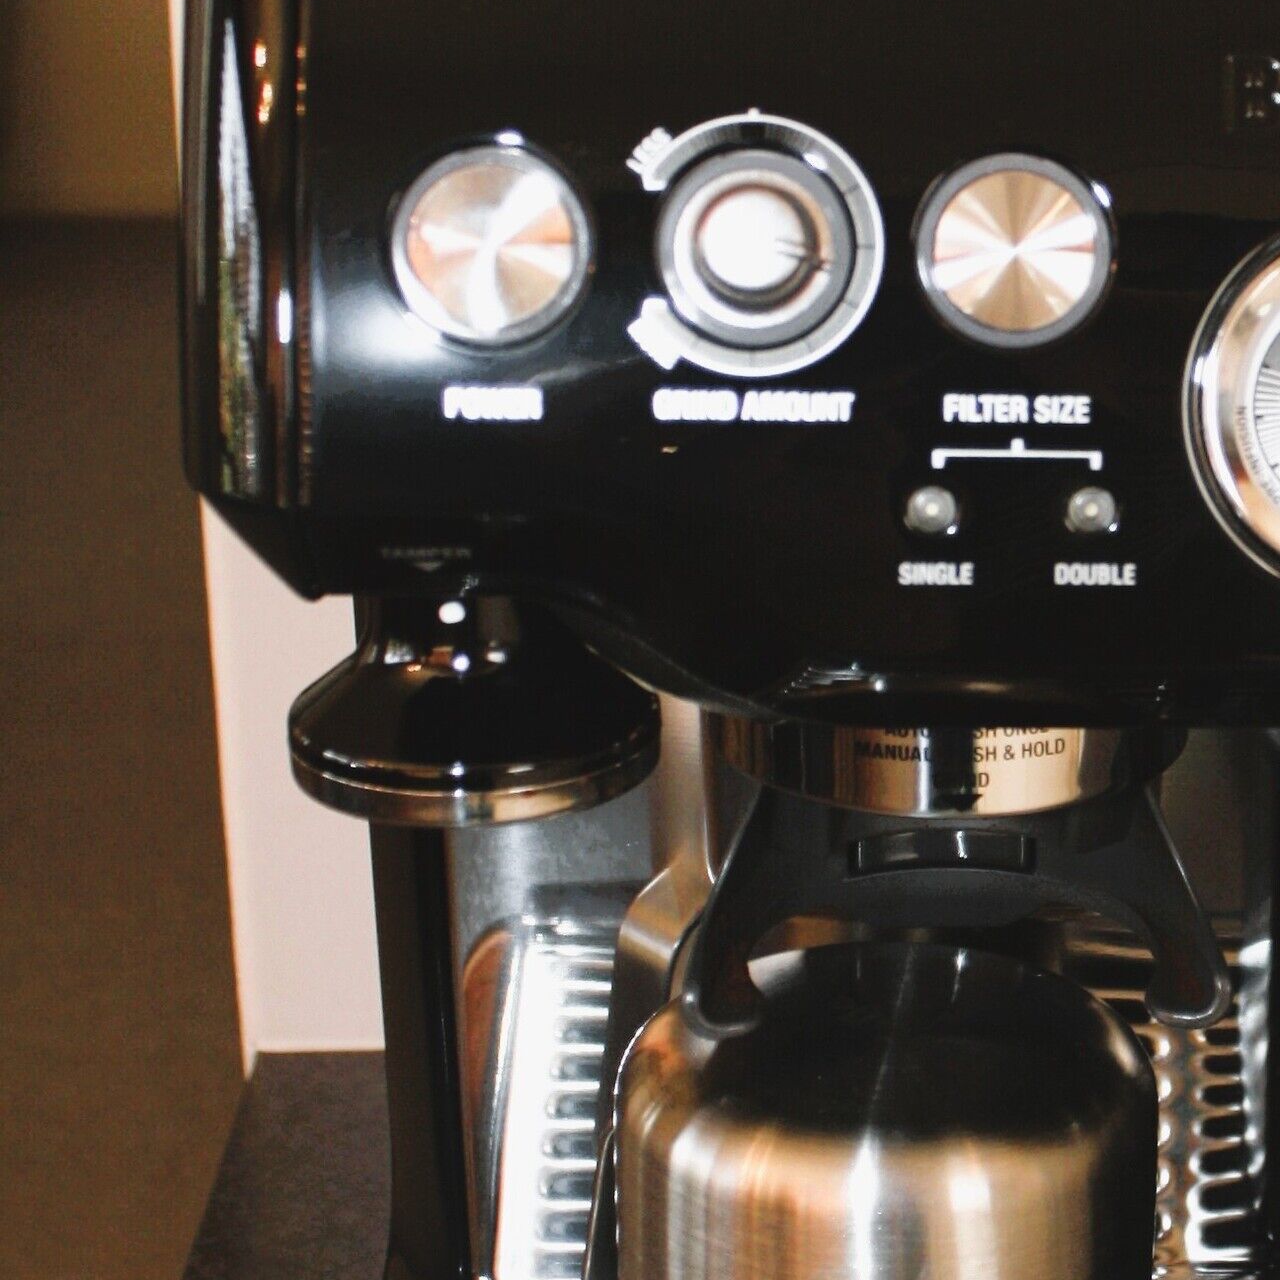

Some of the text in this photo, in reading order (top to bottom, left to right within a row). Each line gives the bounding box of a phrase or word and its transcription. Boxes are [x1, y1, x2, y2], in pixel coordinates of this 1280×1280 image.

[652, 388, 856, 423] GRIND AMOUNT
[943, 392, 1091, 425] FILTER SIZE
[898, 561, 974, 586] SINGLE
[1053, 562, 1136, 586] DOUBLE
[1003, 745, 1016, 761] &
[1021, 737, 1066, 760] HOLD
